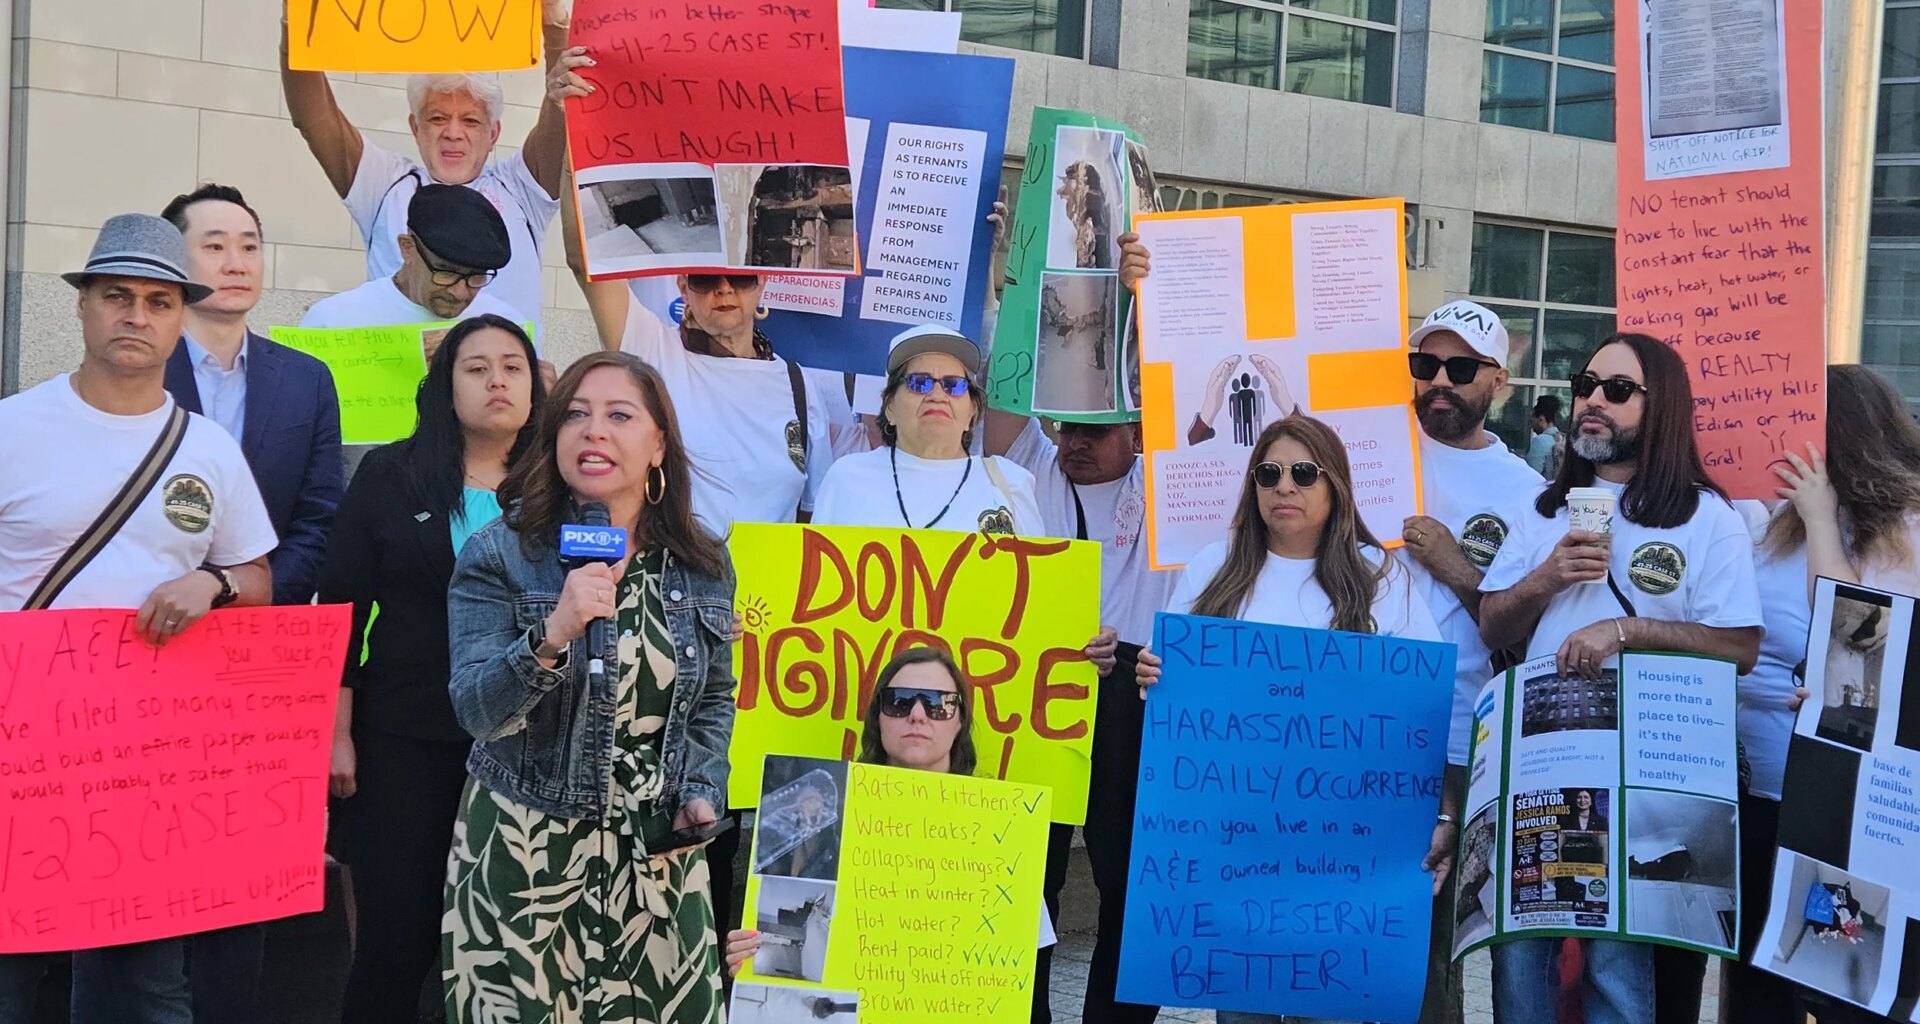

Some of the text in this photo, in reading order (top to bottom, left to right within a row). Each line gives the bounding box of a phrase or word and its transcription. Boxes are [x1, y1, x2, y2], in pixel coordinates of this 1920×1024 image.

[649, 8, 666, 19] in
[686, 3, 744, 21] better
[610, 32, 697, 63] 41-25
[709, 33, 769, 51] CASE
[790, 32, 829, 50] ST!
[579, 72, 843, 117] DON'T MAKE
[585, 130, 802, 163] US LAUGH!
[898, 138, 964, 152] OUR RIGHTS
[1649, 135, 1709, 152] SHUT-OFF
[1714, 128, 1756, 143] NOTICE
[896, 154, 968, 169] AS TERNANTS
[1656, 146, 1772, 173] NATIONAL GRID!
[893, 171, 967, 186] IS TO RECEIVE
[890, 187, 906, 195] AN
[888, 203, 948, 218] IMMEDIATE
[1629, 194, 1662, 218] NO
[1670, 189, 1728, 206] tenant
[885, 219, 944, 234] RESPONSE
[1623, 213, 1808, 244] have to live with the
[883, 236, 914, 248] FROM
[1702, 245, 1729, 260] fear
[1739, 245, 1778, 260] that
[1786, 241, 1811, 255] the
[880, 253, 959, 270] MANAGEMENT
[886, 270, 952, 286] REGARDING
[1623, 266, 1809, 303] lights, heat, hot water, or
[764, 291, 838, 308] EMERGENCIAS.
[875, 287, 947, 303] REPAIRS AND
[873, 303, 955, 322] EMERGENCIES.
[1624, 291, 1788, 327] cooking gas will be
[1695, 329, 1761, 346] because
[1700, 353, 1792, 379] REALTY
[1692, 382, 1819, 411] pay utility bills
[1695, 410, 1816, 433] Edison or the
[1166, 462, 1207, 470] CONOZCA
[1703, 446, 1743, 470] Grid!
[1167, 481, 1212, 489] ESCUCHAR
[791, 527, 1071, 640] DON'T
[1160, 616, 1443, 681] RETALIATION
[736, 626, 1089, 741] IGNRE
[1638, 670, 1703, 685] Housing is
[1269, 679, 1305, 700] and
[1638, 692, 1671, 701] more
[1675, 693, 1702, 704] than
[1150, 703, 1429, 749] HARASSMENT is
[1639, 711, 1673, 722] place
[1677, 714, 1689, 722] to
[1662, 731, 1682, 742] the
[59, 750, 103, 771] build
[113, 742, 134, 761] an
[203, 732, 256, 760] paper
[1639, 749, 1726, 768] foundation for
[10, 757, 287, 801] would probably be safer than
[1145, 766, 1155, 782] a
[1174, 755, 1282, 801] DAILY
[1296, 766, 1442, 800] OCCURRENCE
[1640, 769, 1687, 784] healthy
[1873, 757, 1912, 778] base de
[852, 764, 1024, 816] Rats in kitchen?
[1871, 774, 1913, 795] familias
[1515, 805, 1570, 820] JESSICA RAMOS
[1516, 794, 1564, 811] SENATOR
[1868, 793, 1920, 815] saludable
[139, 777, 320, 862] CASE ST
[854, 809, 982, 845] Water leaks?
[1221, 811, 1371, 845] you live in an
[1516, 815, 1557, 829] INVOLVED
[1866, 810, 1920, 833] comunida
[1865, 825, 1904, 846] fuertes.
[940, 855, 1005, 883] ceilings?
[1221, 859, 1280, 882] owned
[854, 877, 900, 899] Heat
[905, 884, 921, 900] in
[77, 888, 237, 930] THE HELL
[1149, 898, 1408, 939] WE DESERVE
[855, 907, 961, 937] Hot water?
[859, 934, 954, 968] Rent paid?
[854, 963, 906, 994] Utility
[950, 971, 974, 986] off
[1170, 945, 1371, 999] BETTER!
[925, 993, 985, 1015] water?
